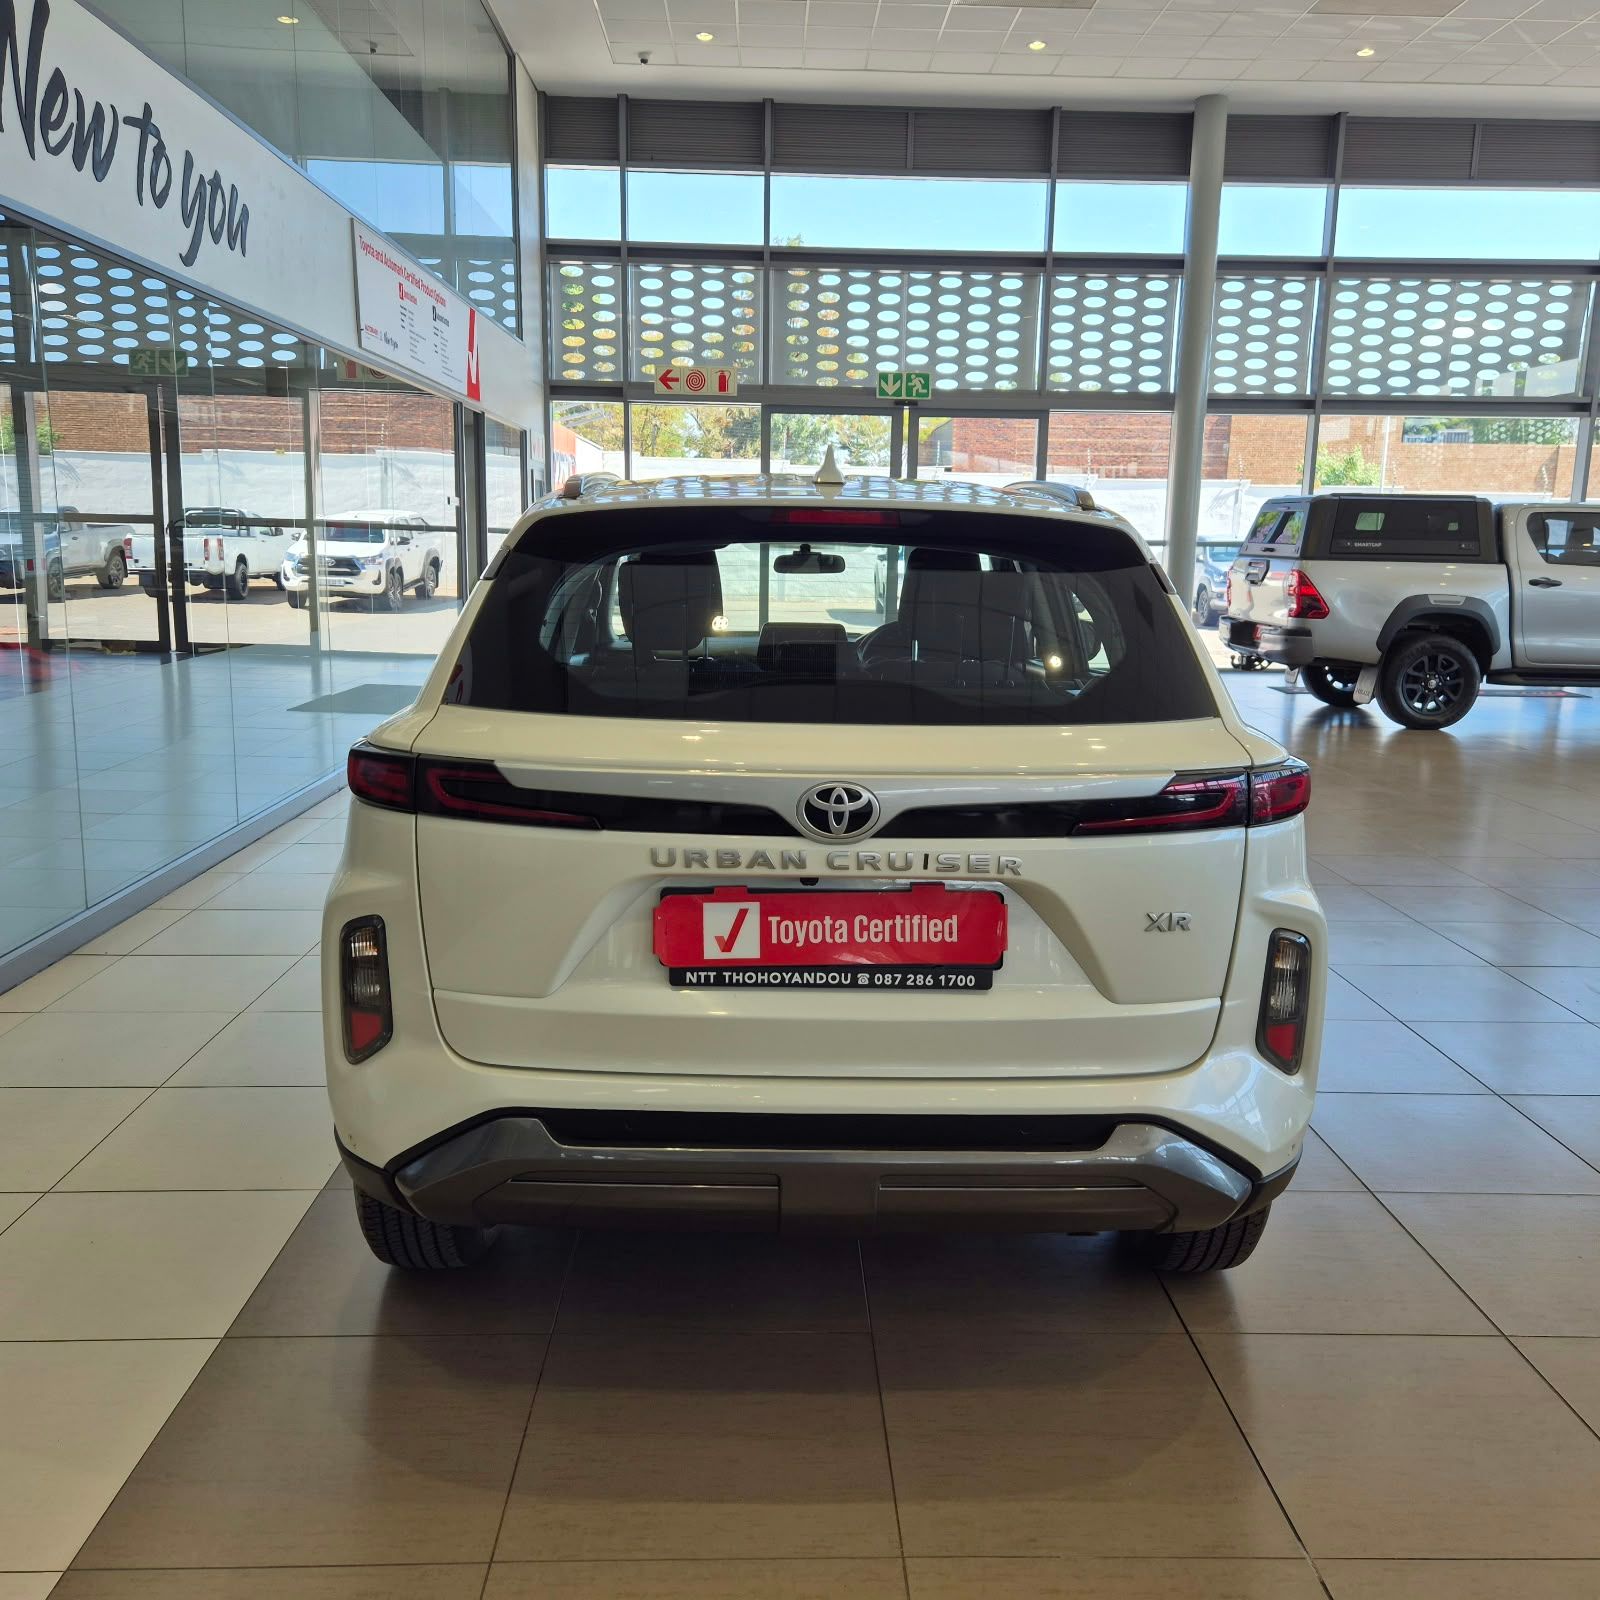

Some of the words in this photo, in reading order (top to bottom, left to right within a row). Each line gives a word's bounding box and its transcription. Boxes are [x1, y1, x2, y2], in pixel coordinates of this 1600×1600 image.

[0, 0, 119, 182] New
[123, 102, 172, 209] to
[179, 150, 249, 267] you
[650, 847, 807, 870] URBAN
[826, 850, 1024, 876] CRUISER
[767, 915, 848, 947] Toyota
[853, 914, 958, 943] Certified
[685, 971, 717, 984] NTT
[722, 971, 852, 985] THOHOYANDOU
[874, 973, 902, 985] 087
[906, 974, 934, 986] 286
[938, 974, 976, 987] 1700
